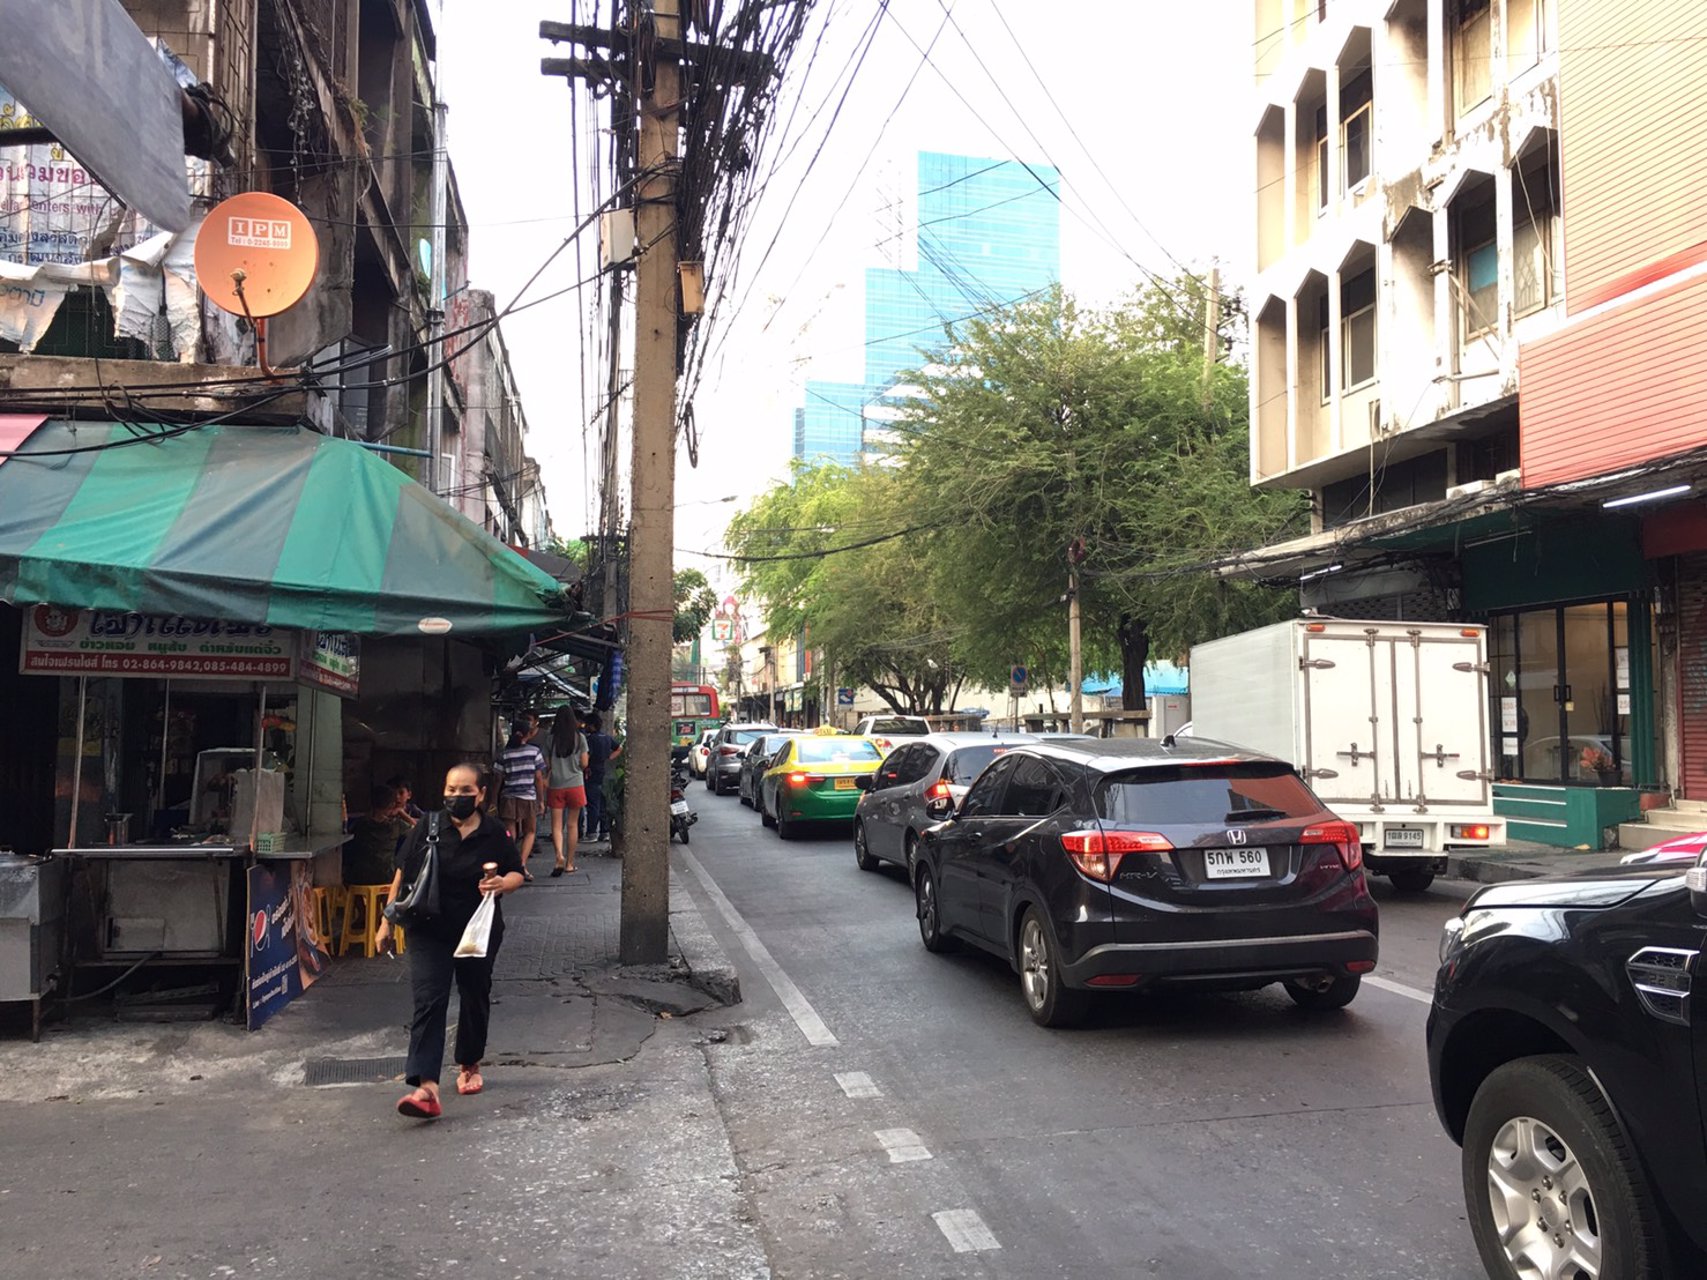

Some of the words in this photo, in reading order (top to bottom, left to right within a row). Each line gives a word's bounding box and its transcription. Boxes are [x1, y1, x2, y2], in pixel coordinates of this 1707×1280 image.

[235, 221, 287, 238] IPM
[102, 654, 119, 669] โทร
[1239, 850, 1262, 864] 560
